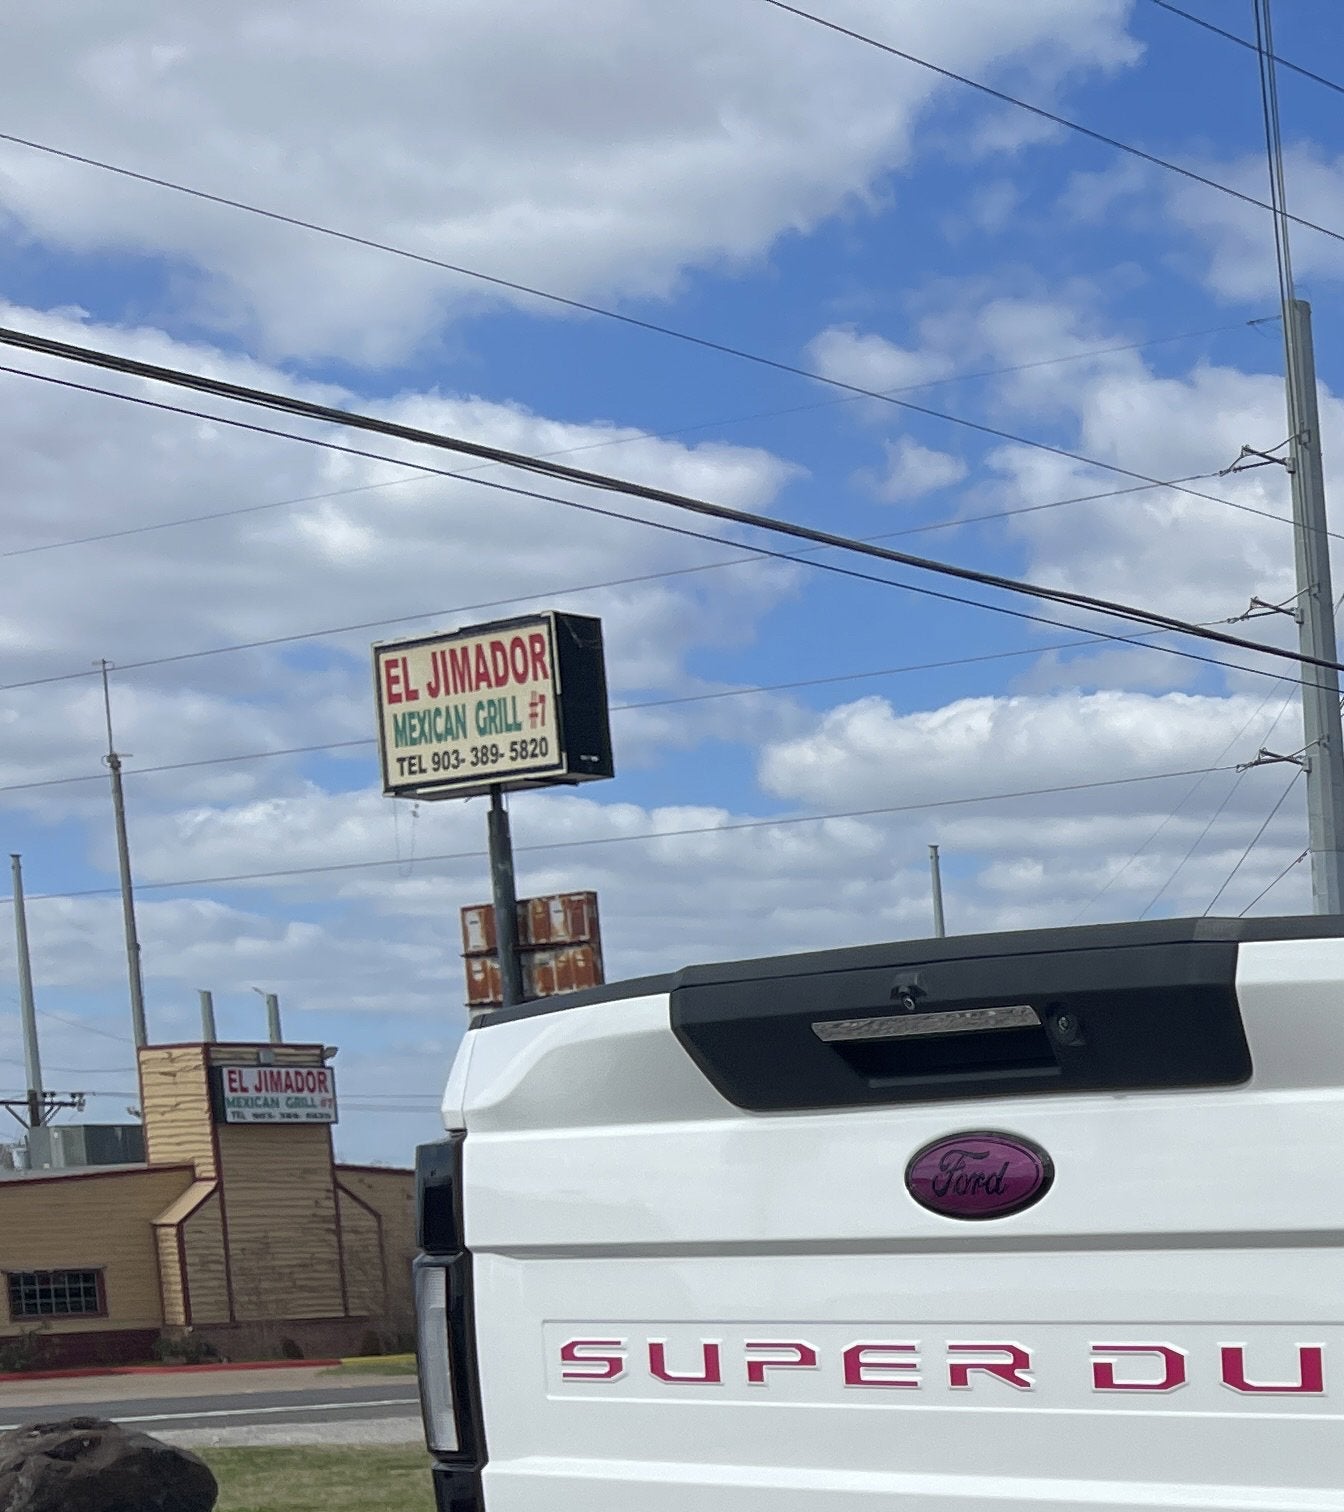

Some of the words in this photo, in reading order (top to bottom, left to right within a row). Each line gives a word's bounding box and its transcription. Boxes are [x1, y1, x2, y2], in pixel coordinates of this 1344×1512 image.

[385, 656, 419, 704] EL
[427, 633, 549, 698] JIMADOR
[393, 704, 467, 748] MEXICAN
[475, 695, 522, 736] GRILL
[529, 691, 547, 730] #7
[397, 752, 427, 776] TEL
[510, 737, 548, 761] 5820
[226, 1096, 279, 1108] MEXICAN
[285, 1097, 317, 1107] GRILL
[228, 1070, 249, 1093] EL
[254, 1070, 329, 1093] JIMADOR
[932, 1149, 1010, 1198] Ford
[559, 1338, 1037, 1390] SUPER
